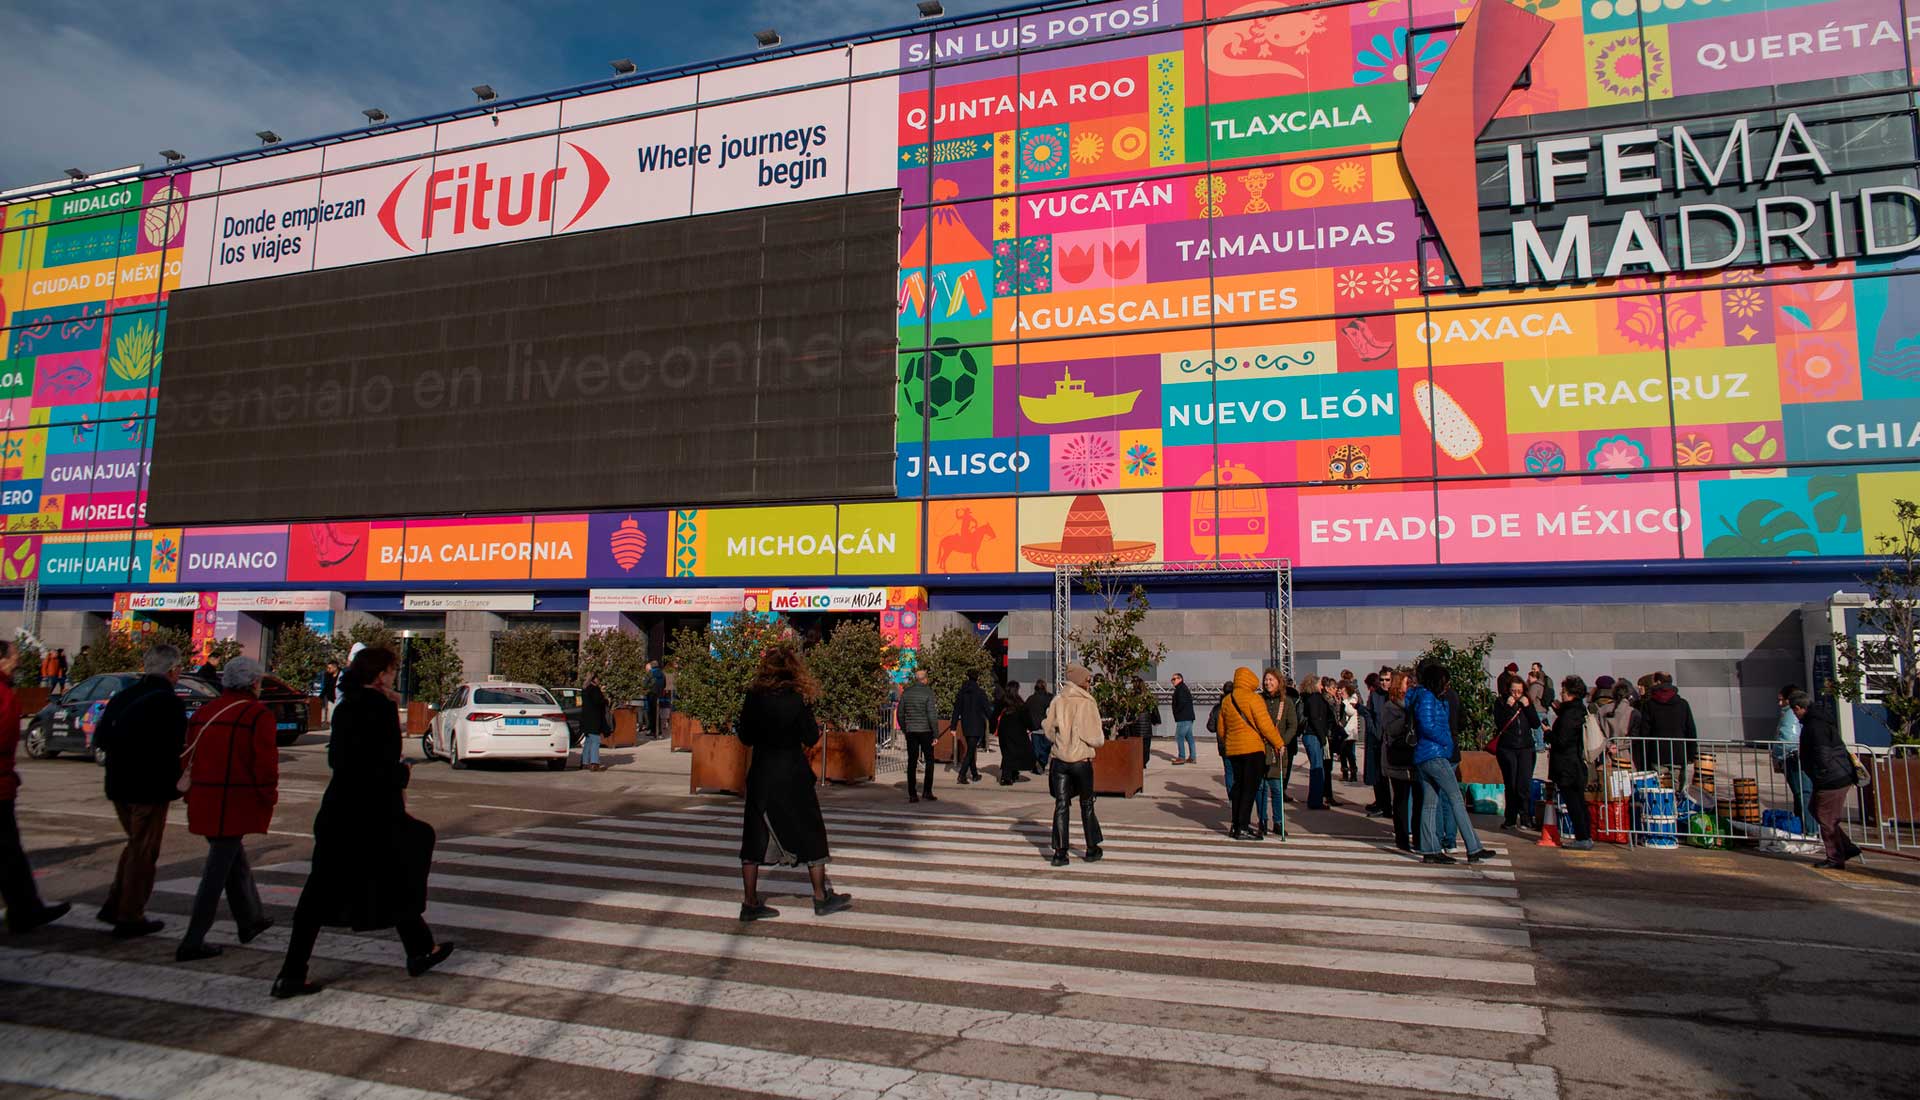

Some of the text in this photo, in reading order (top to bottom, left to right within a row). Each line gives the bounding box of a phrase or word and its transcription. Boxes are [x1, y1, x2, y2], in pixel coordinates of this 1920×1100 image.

[909, 1, 1159, 63] SAN LUIS POTOSÍ
[906, 77, 1135, 131] QUINTANA ROO
[1211, 104, 1372, 142] TLAXCALA
[638, 125, 827, 173] Where journeys
[1506, 113, 1832, 206] IFEMA
[758, 153, 827, 189] begin
[63, 190, 132, 215] HIDALGO
[223, 198, 365, 238] Donde empiezan
[420, 162, 567, 240] Fitur
[1028, 182, 1173, 219] YUCATÁN
[220, 235, 301, 265] los viajes
[1176, 221, 1396, 262] TAMAULIPAS
[1511, 185, 1920, 284] MADRID
[32, 262, 182, 296] CIUDAD DE MÉXICO
[1009, 287, 1298, 332] AGUASCALIENTES
[1415, 312, 1573, 345] OAXACA
[0, 372, 23, 388] OA
[413, 362, 482, 409] en
[1529, 372, 1751, 409] VERACRUZ
[1169, 389, 1394, 427] NUEVO LEÓN
[51, 462, 151, 481] GUANAJUA
[906, 451, 1030, 478] JALISCO
[1310, 504, 1692, 543] ESTADO DE MÉXICO
[188, 551, 278, 570] DURANGO
[380, 541, 573, 564] BAJA CALIFORNIA
[727, 528, 896, 557] MICHOACÁN
[47, 556, 142, 573] CHIHUAHUA
[852, 592, 882, 608] MODA
